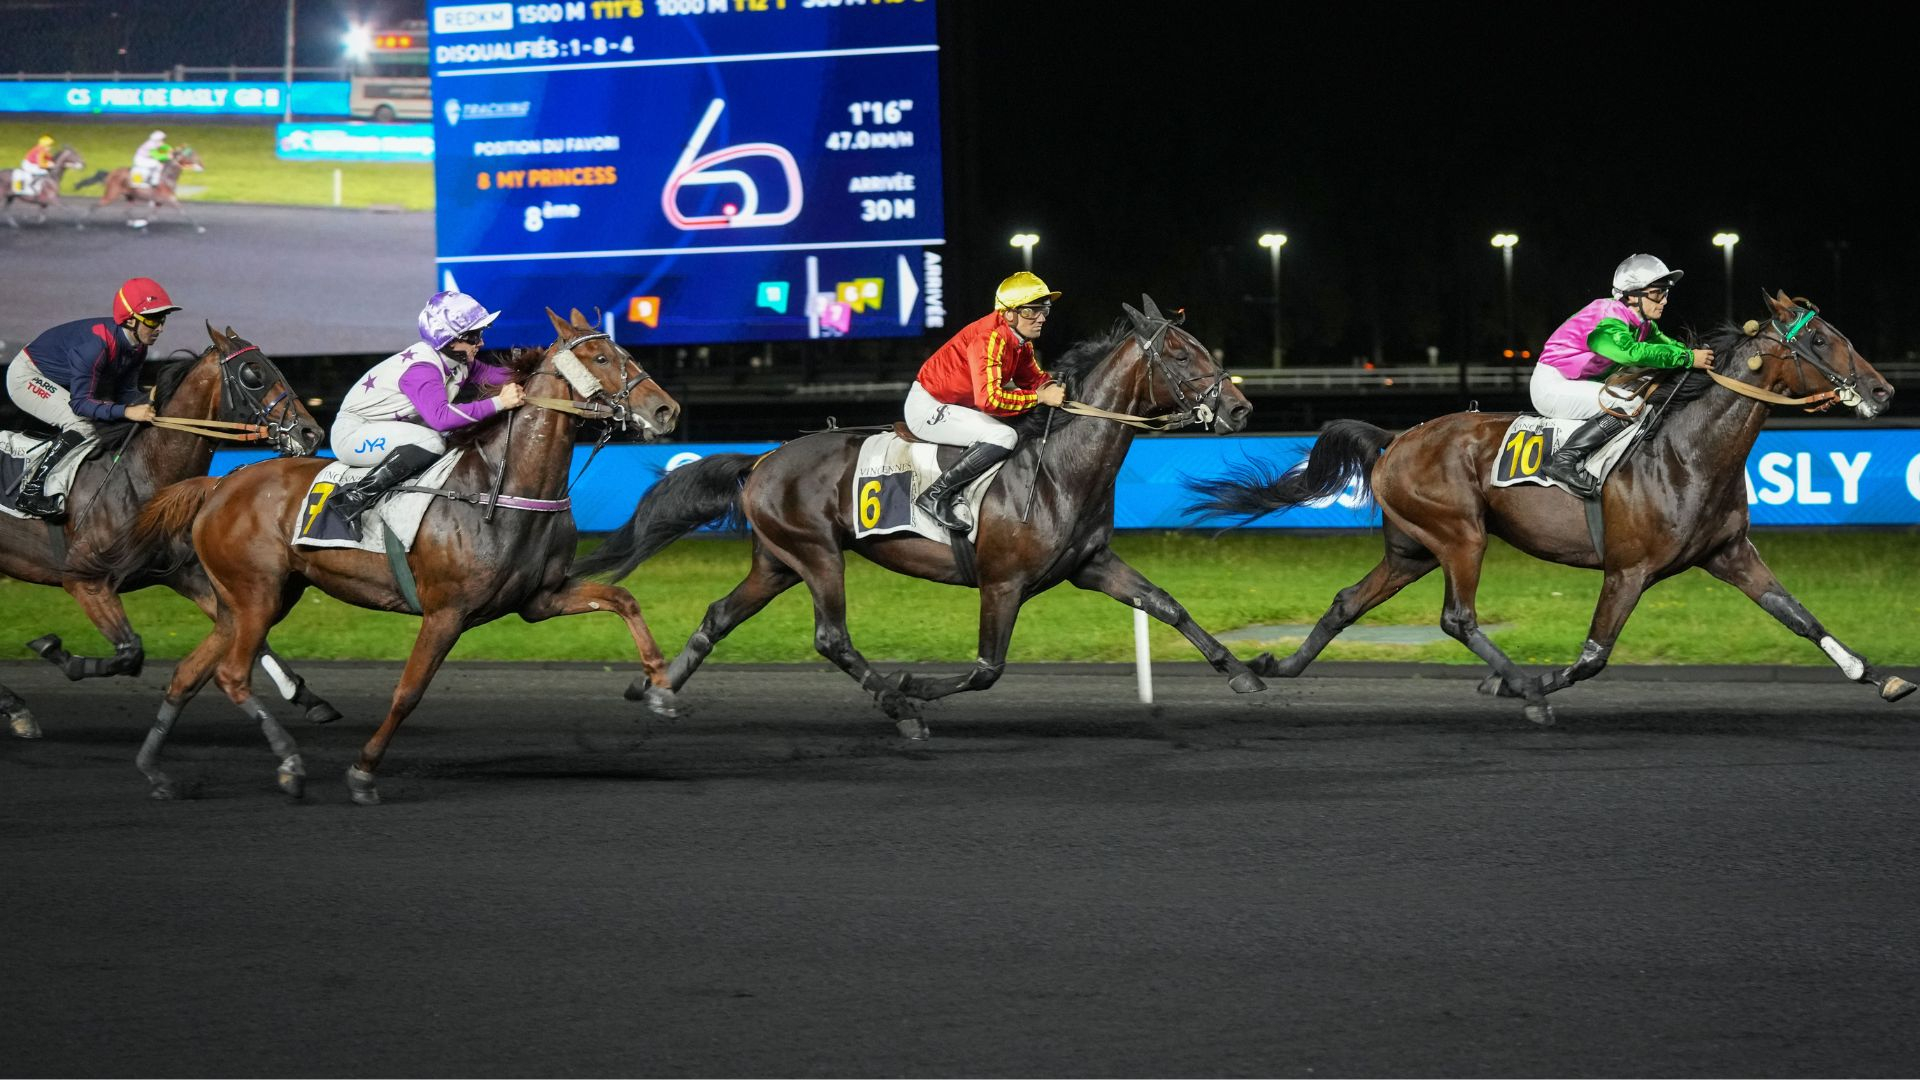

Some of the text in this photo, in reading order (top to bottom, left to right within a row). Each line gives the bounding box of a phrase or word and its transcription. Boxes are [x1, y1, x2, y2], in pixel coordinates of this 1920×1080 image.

[444, 10, 504, 27] REDKM
[517, 4, 563, 23] 1500
[565, 1, 586, 21] M
[473, 135, 620, 157] POSITION DU FAVORI
[477, 166, 618, 190] 8 MY PRINCESS
[848, 172, 916, 193] ARRIVÉE
[861, 198, 915, 222] 30 M
[27, 381, 52, 400] TURF
[31, 376, 58, 394] PARIS
[354, 437, 386, 454] JYR
[1506, 431, 1544, 478] 10
[303, 482, 336, 535] 7
[860, 480, 881, 529] 6
